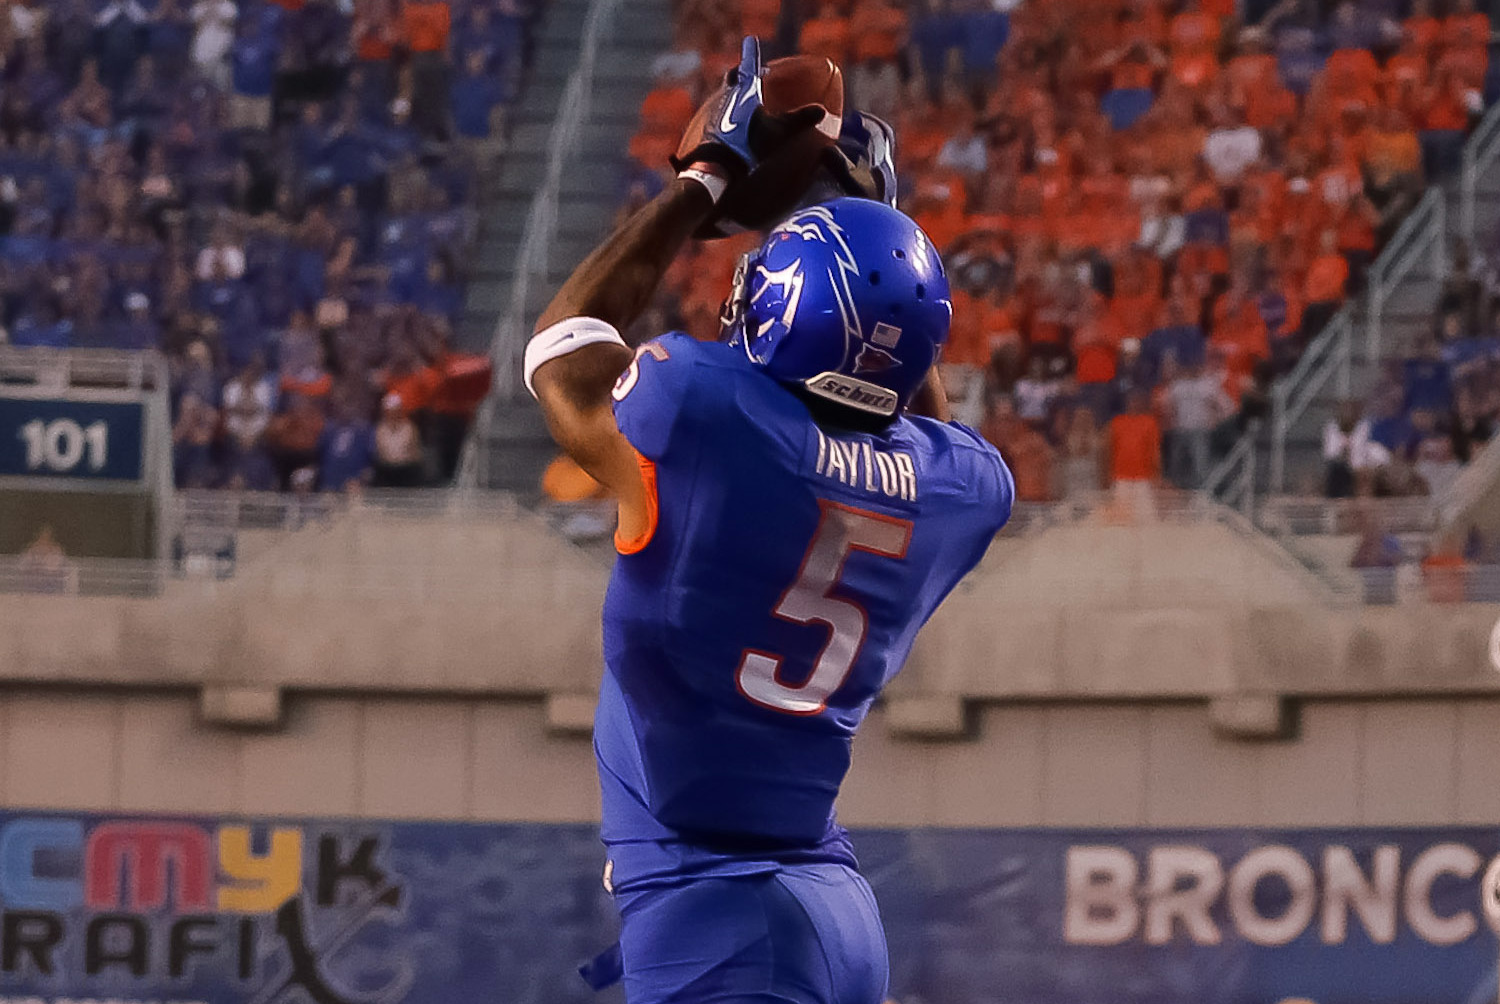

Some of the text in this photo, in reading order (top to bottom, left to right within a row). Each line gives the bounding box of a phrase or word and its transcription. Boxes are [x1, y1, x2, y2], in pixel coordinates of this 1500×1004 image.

[20, 420, 108, 470] 101
[815, 428, 917, 502] TAYLOR
[735, 498, 915, 716] 5
